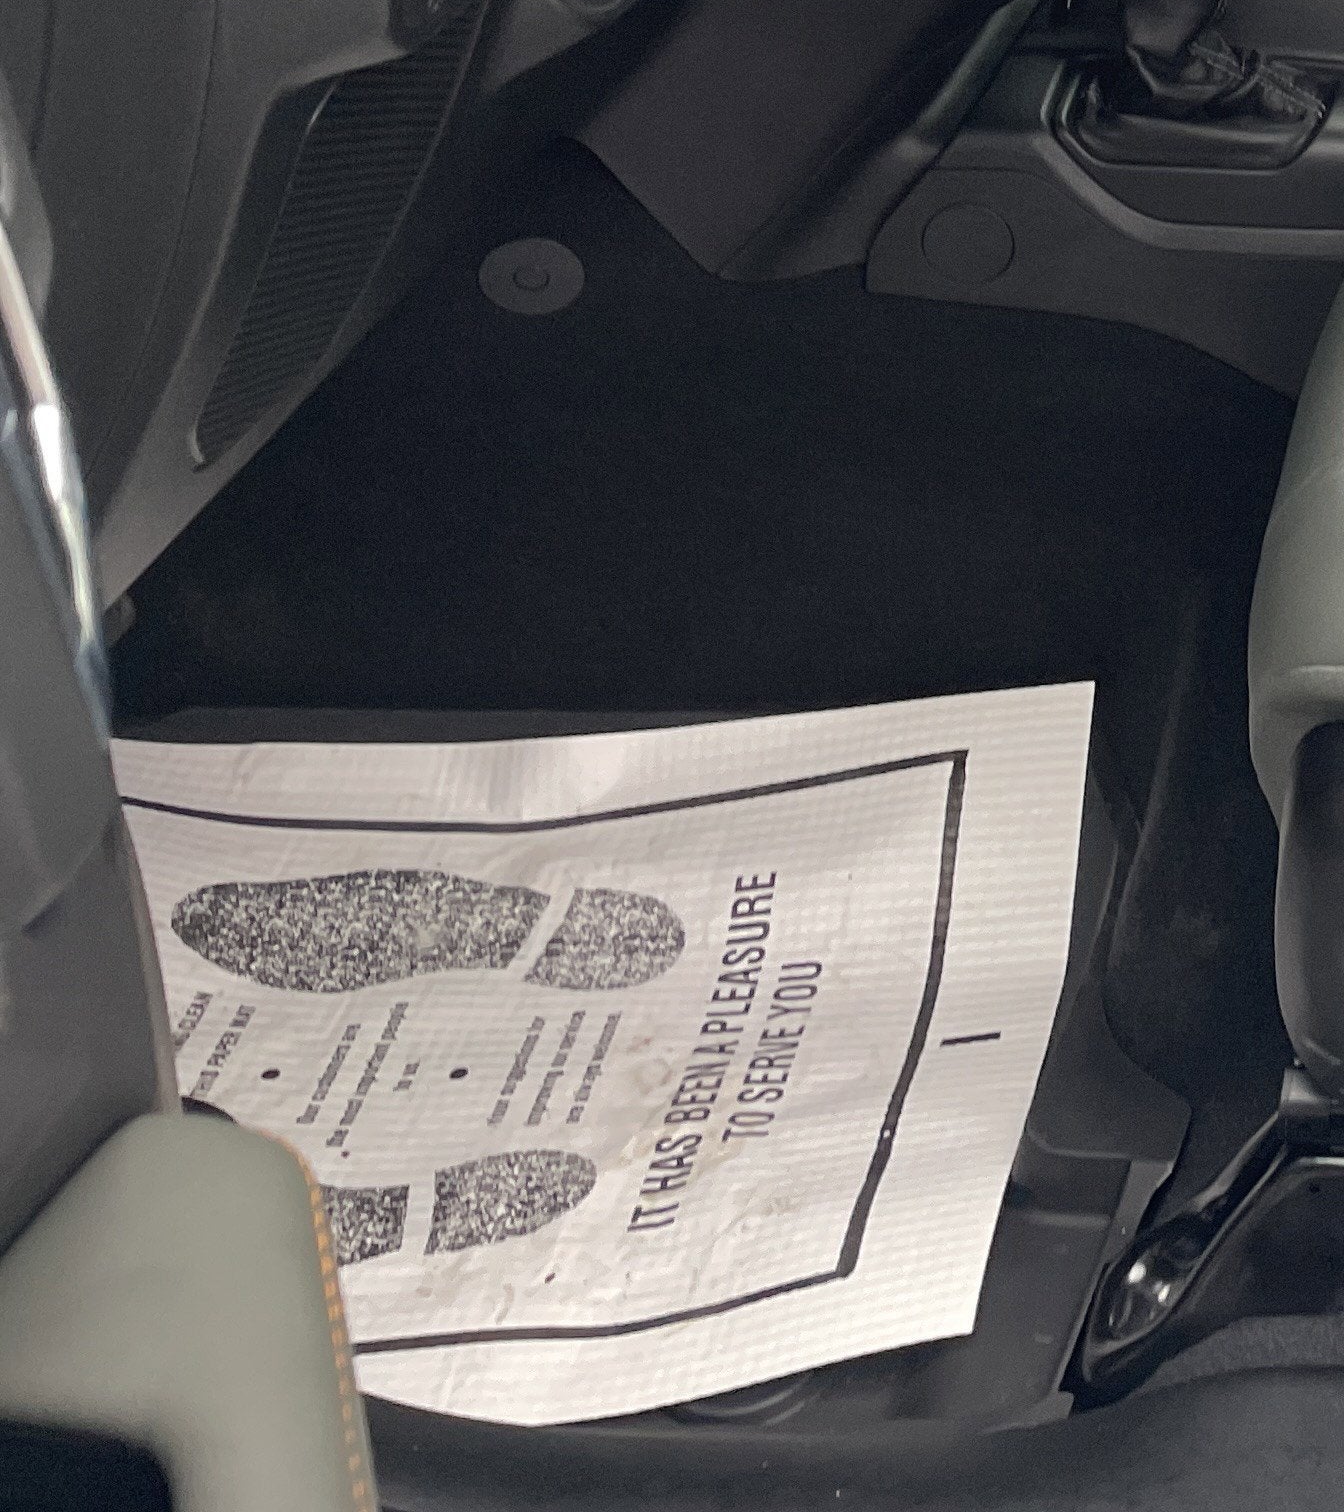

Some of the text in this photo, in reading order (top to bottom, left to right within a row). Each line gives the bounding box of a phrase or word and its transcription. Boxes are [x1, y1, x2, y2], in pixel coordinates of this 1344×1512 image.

[627, 870, 778, 1231] IT HAS BEEN A PLEASURE
[721, 960, 823, 1143] TO SERVE YOU
